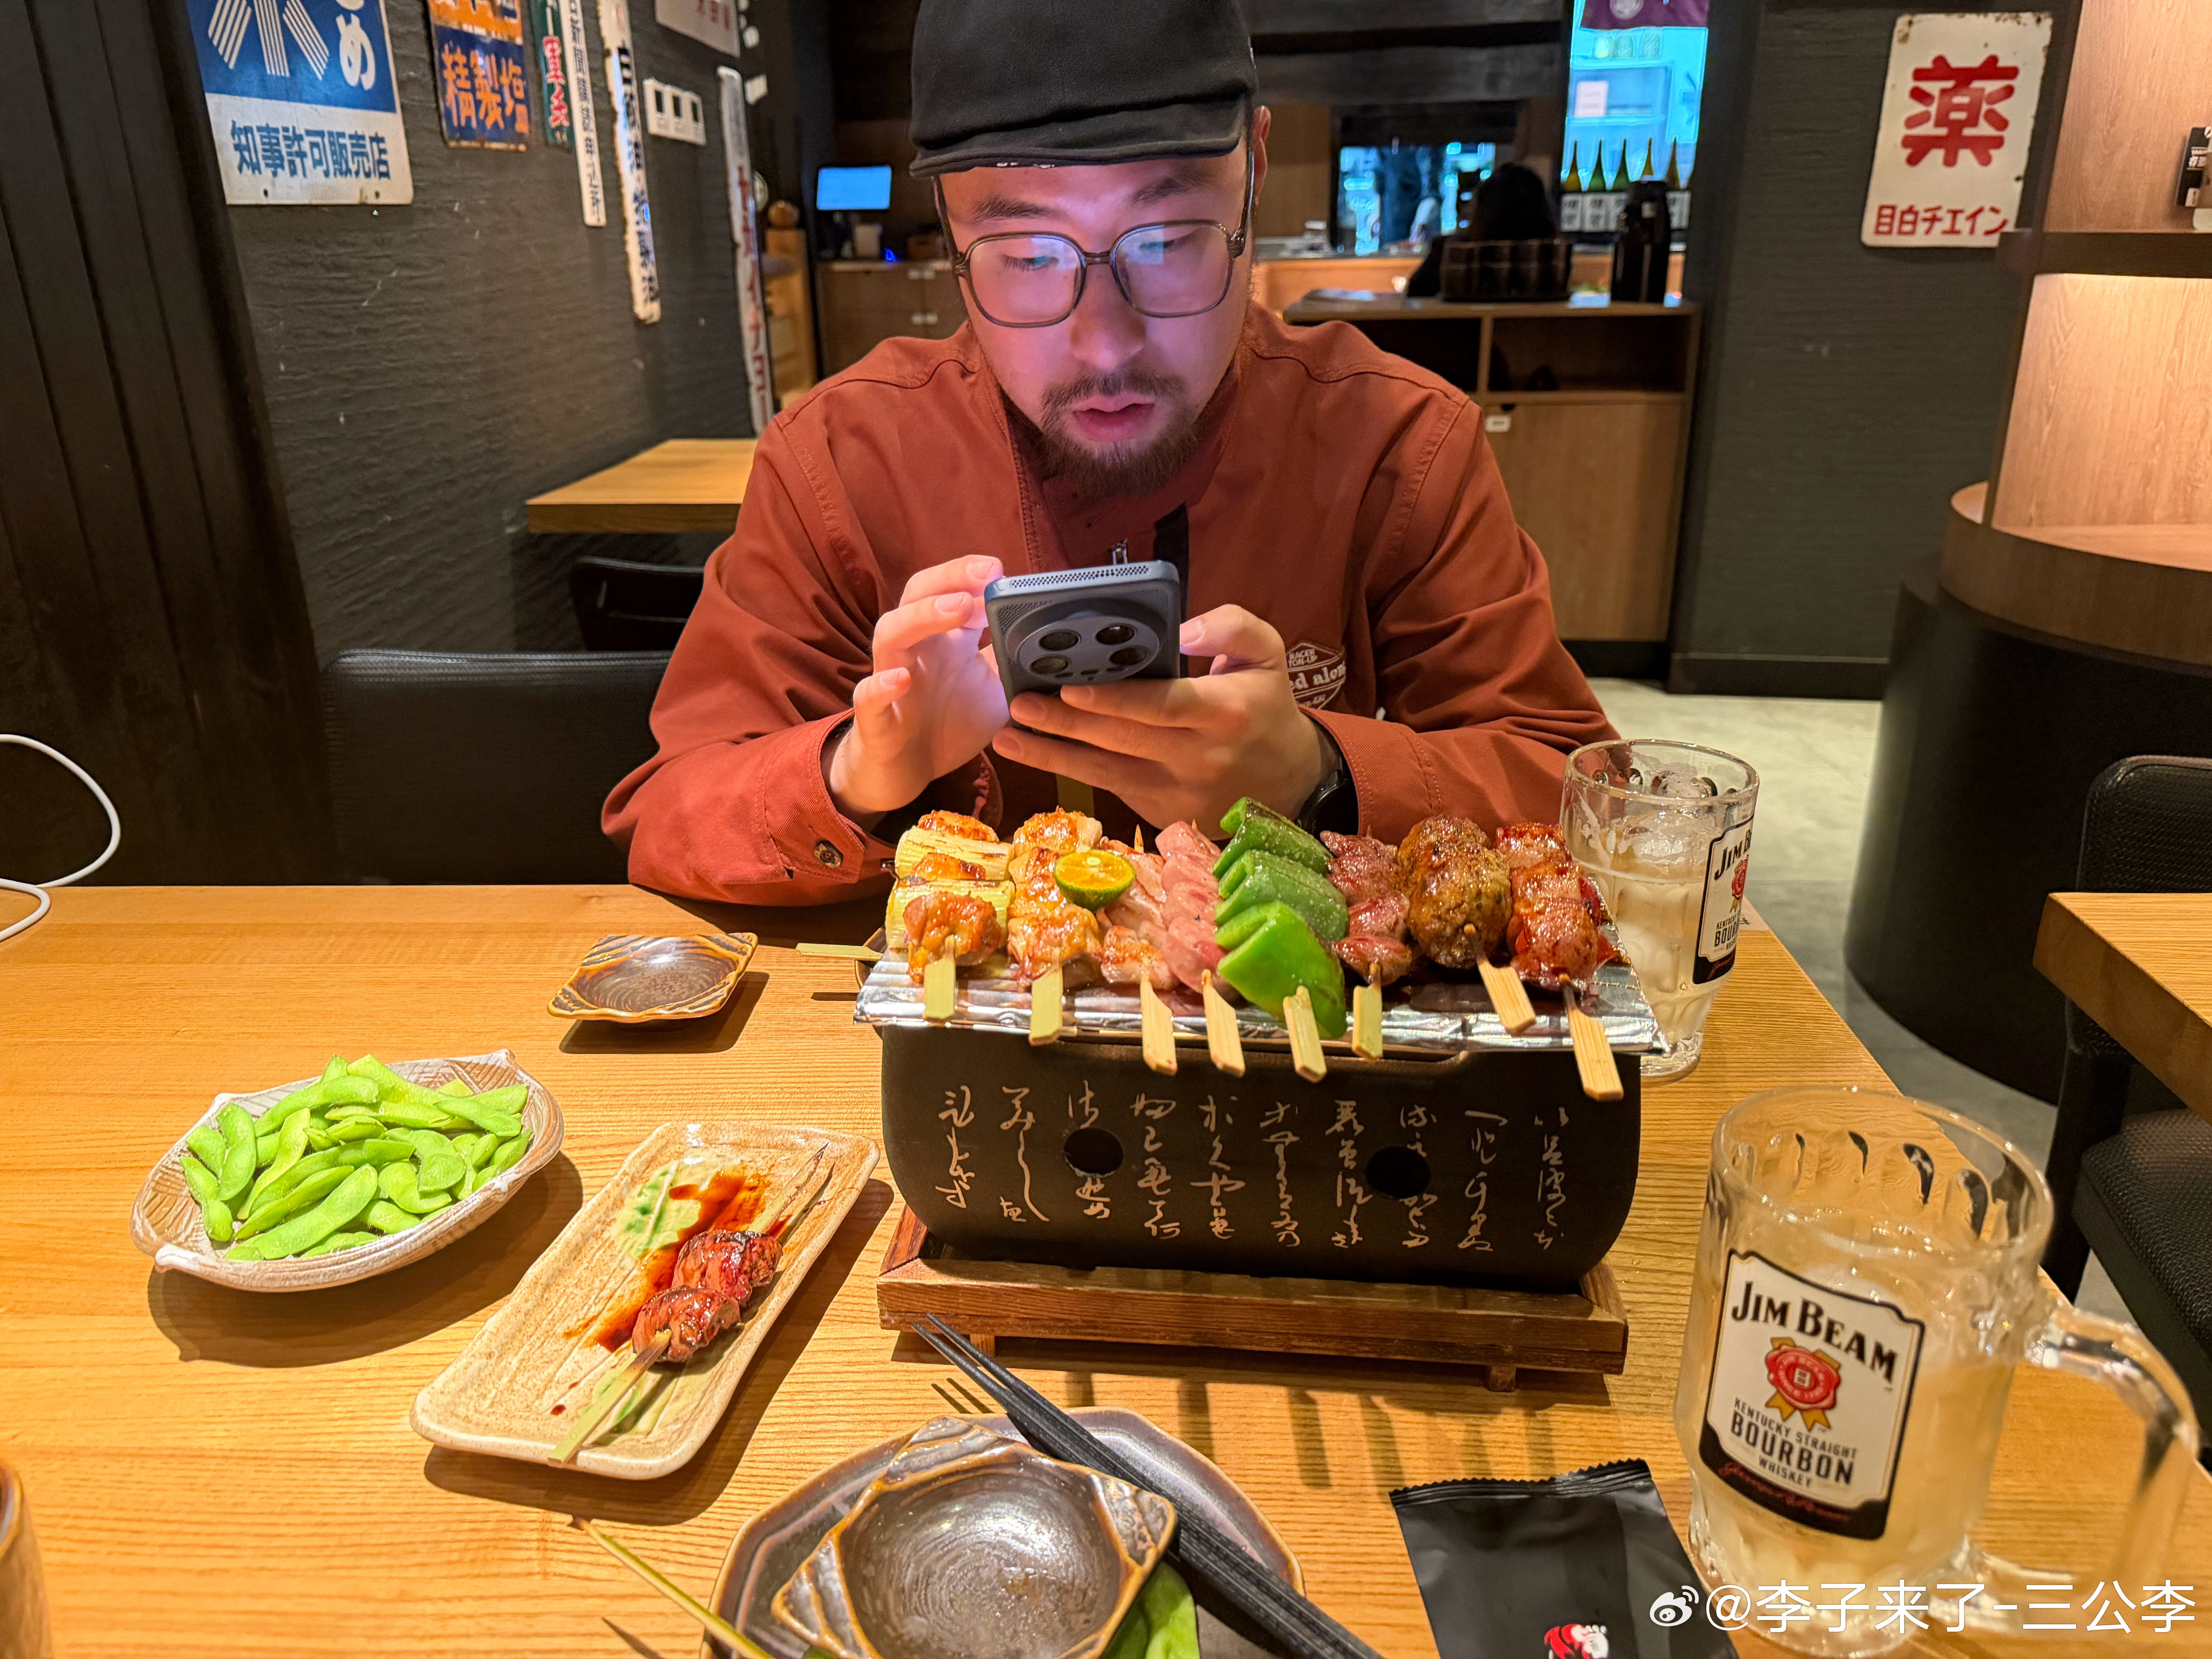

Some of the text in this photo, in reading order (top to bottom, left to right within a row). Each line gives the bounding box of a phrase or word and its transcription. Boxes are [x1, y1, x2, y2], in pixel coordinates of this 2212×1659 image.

[1901, 54, 2019, 167] 薬
[231, 120, 391, 180] 知事許可販売店
[1714, 840, 1743, 880] JIM
[1731, 1280, 1791, 1328] JIM
[1795, 1295, 1897, 1383] BEAM
[1731, 1409, 1854, 1485] BOURBON
[1733, 1396, 1858, 1459] KENTUCKY STRAIGHT
[1759, 1455, 1813, 1488] WHISKEY
